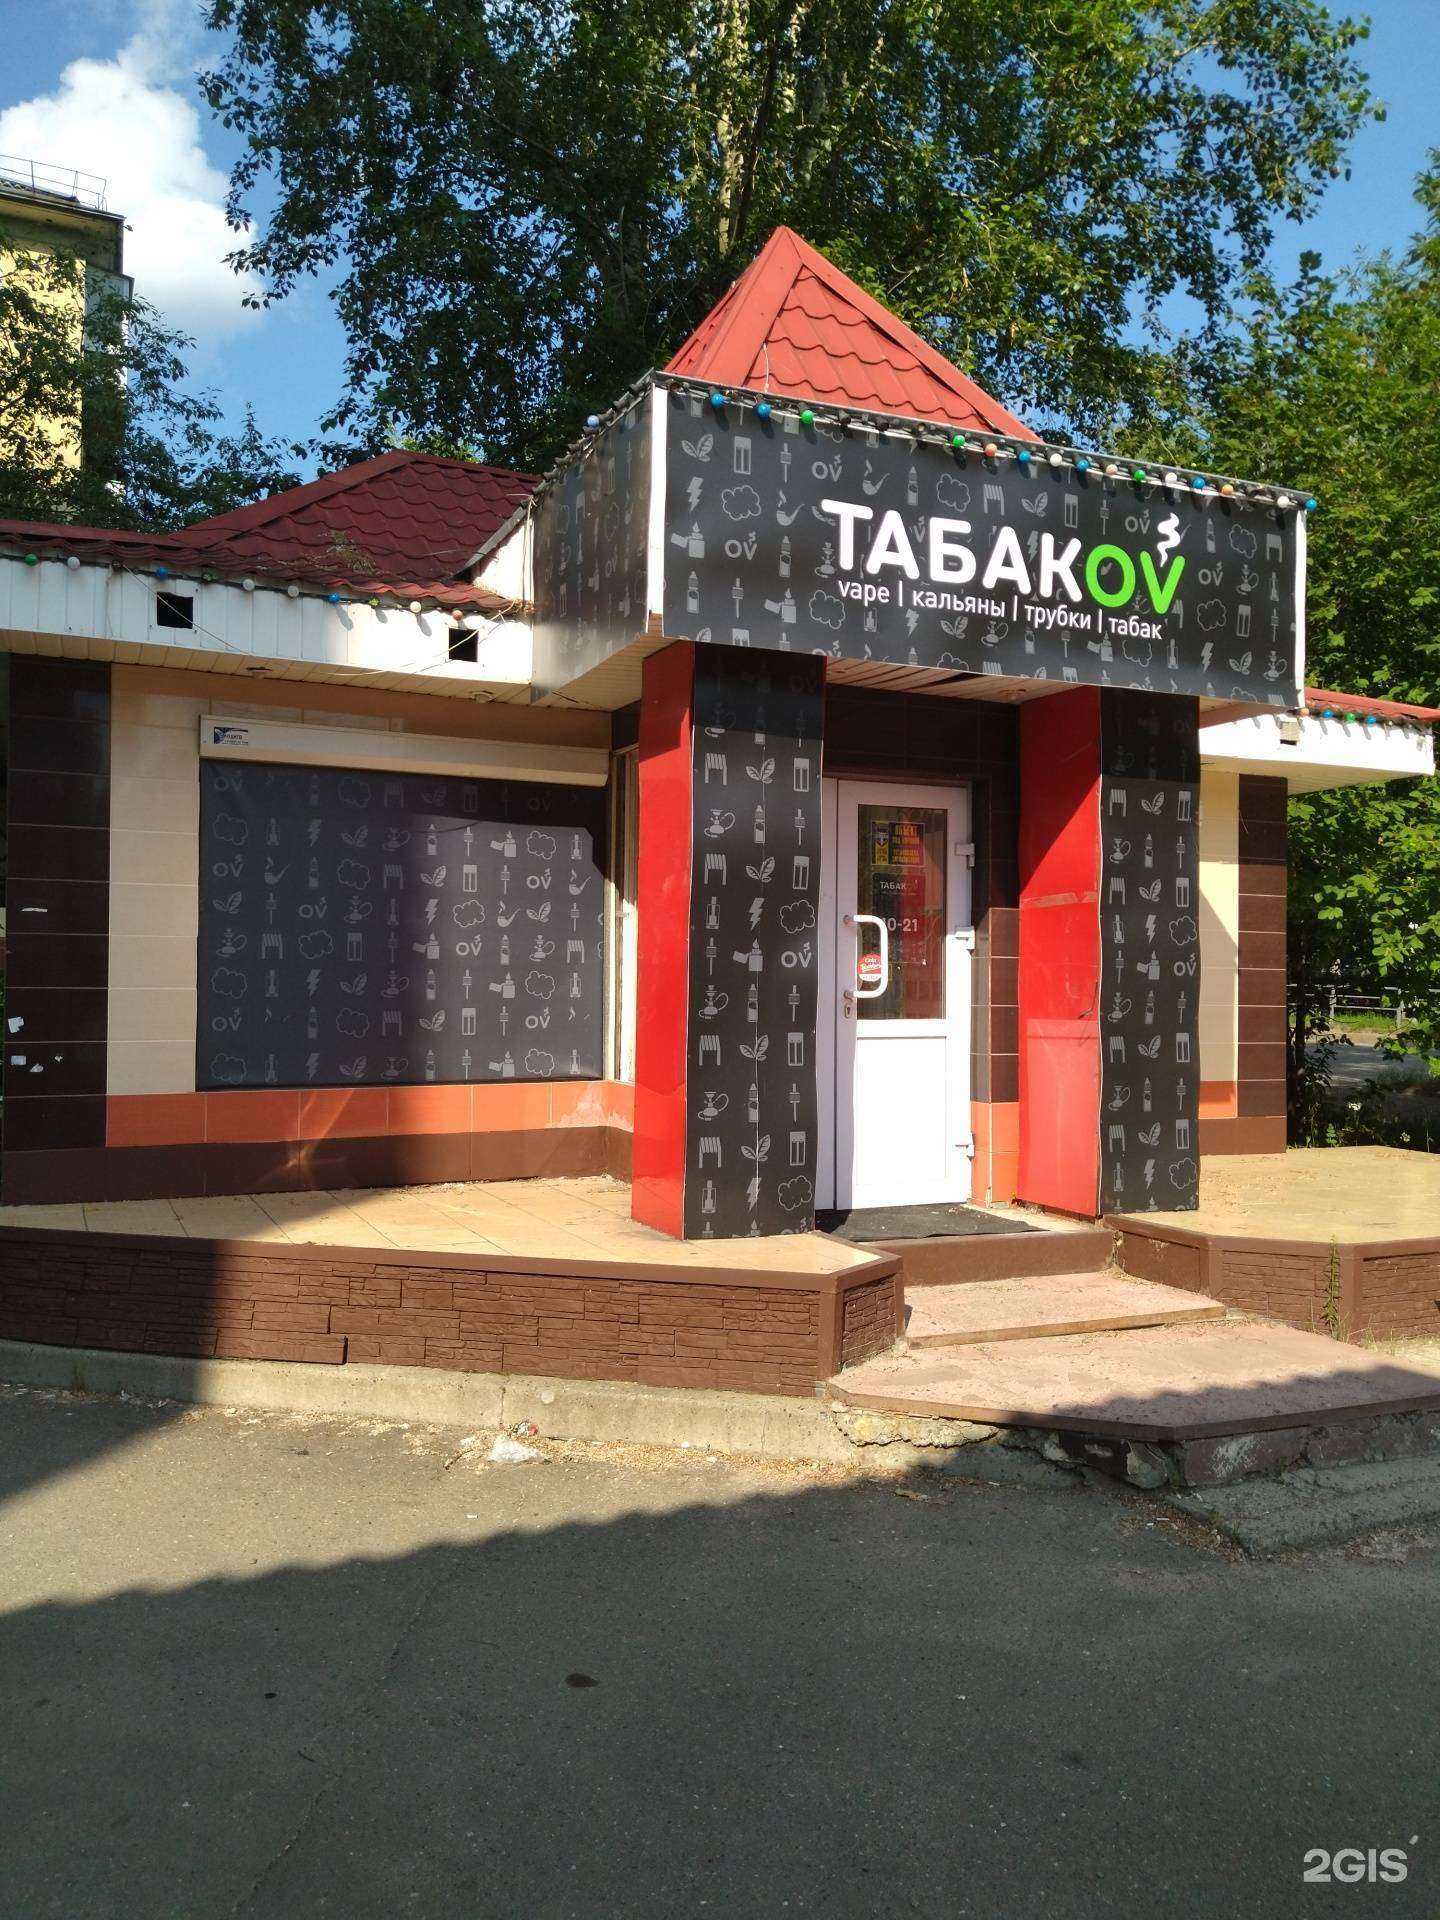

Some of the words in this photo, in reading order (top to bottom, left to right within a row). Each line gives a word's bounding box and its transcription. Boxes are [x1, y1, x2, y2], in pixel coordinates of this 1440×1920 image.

[838, 579, 890, 607] vape
[912, 588, 1006, 618] кальяны
[1024, 603, 1092, 632] трубки
[1108, 615, 1162, 640] табак
